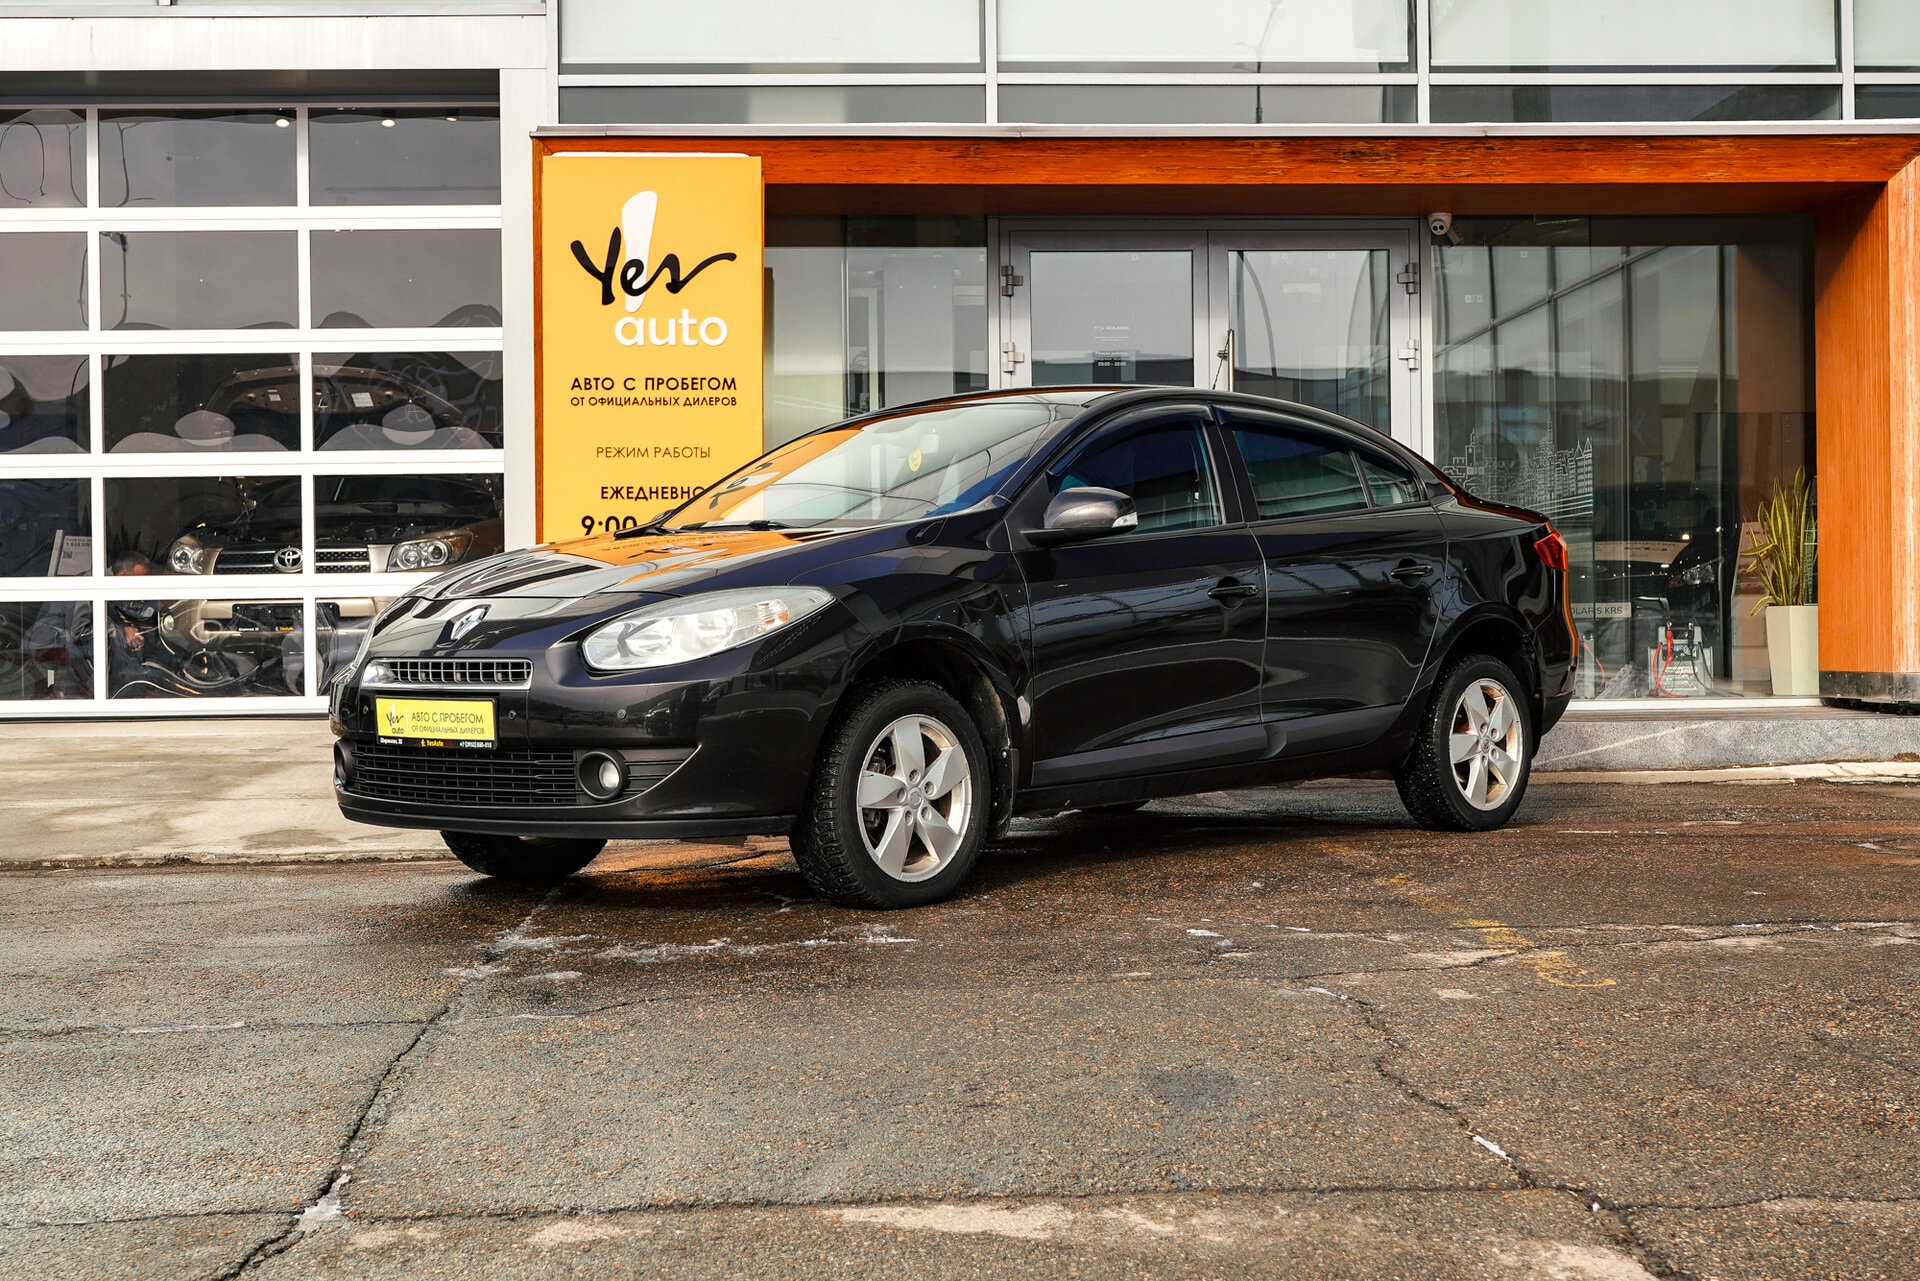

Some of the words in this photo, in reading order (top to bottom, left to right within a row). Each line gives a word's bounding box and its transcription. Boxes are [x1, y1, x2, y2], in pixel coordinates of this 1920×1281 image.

[570, 226, 737, 306] Yes
[614, 308, 728, 346] auto
[570, 377, 615, 391] АВТО
[623, 377, 636, 391] С
[644, 377, 737, 391] ПРОБЕГОМ
[570, 397, 586, 406] ОТ
[588, 396, 680, 407] ОФИЦИАЛЬНЫХ
[683, 397, 737, 407] ДИЛЕРОВ
[596, 446, 650, 459] РЕЖИМ
[654, 446, 711, 459] РАБОТЫ
[601, 486, 706, 502] ЕЖЕДНЕВНО
[1604, 606, 1623, 615] KRS
[411, 712, 430, 723] АВТО
[431, 712, 438, 723] С
[440, 712, 484, 724] ПРОБЕГОМ
[391, 727, 404, 735] auto
[459, 727, 485, 736] ДИЛЕРОВ
